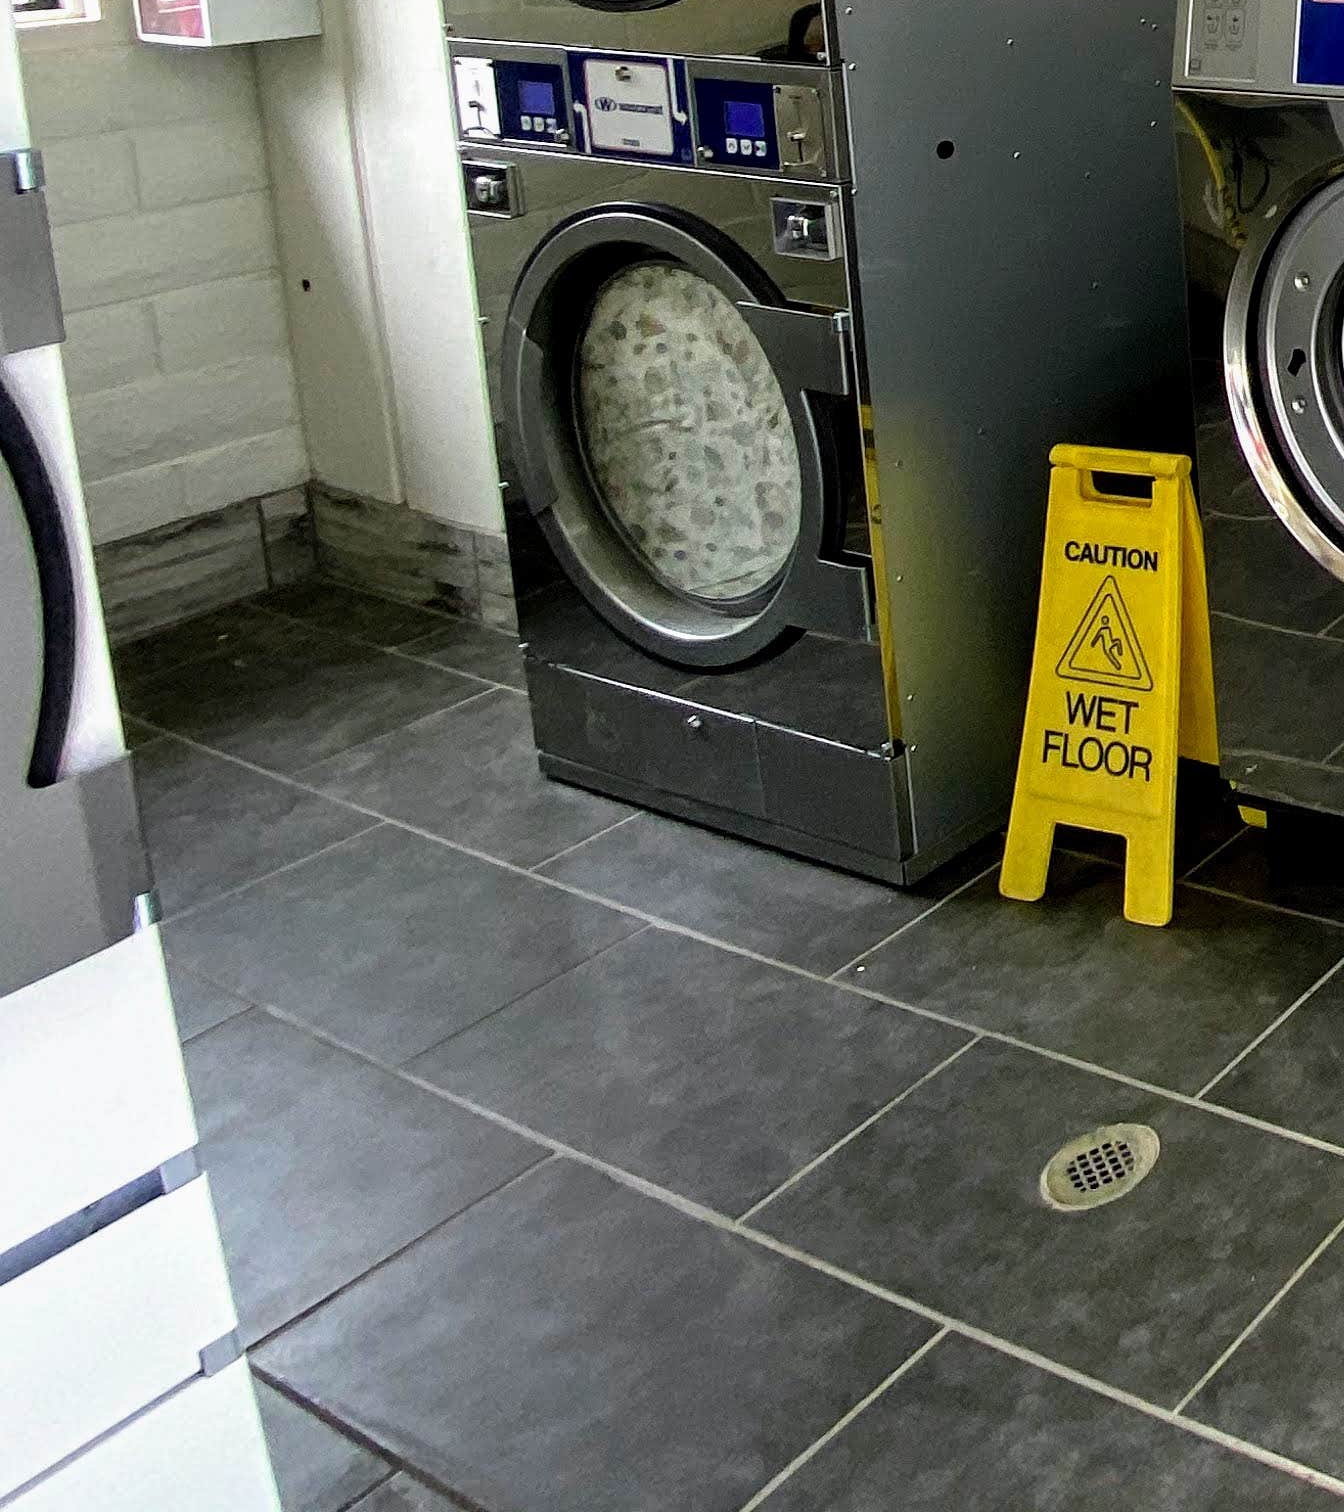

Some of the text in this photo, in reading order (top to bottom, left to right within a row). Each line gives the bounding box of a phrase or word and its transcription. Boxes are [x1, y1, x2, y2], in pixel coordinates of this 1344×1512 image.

[1064, 540, 1159, 572] CAUTION
[1066, 690, 1139, 736] WET
[1041, 730, 1153, 782] FLOOR
